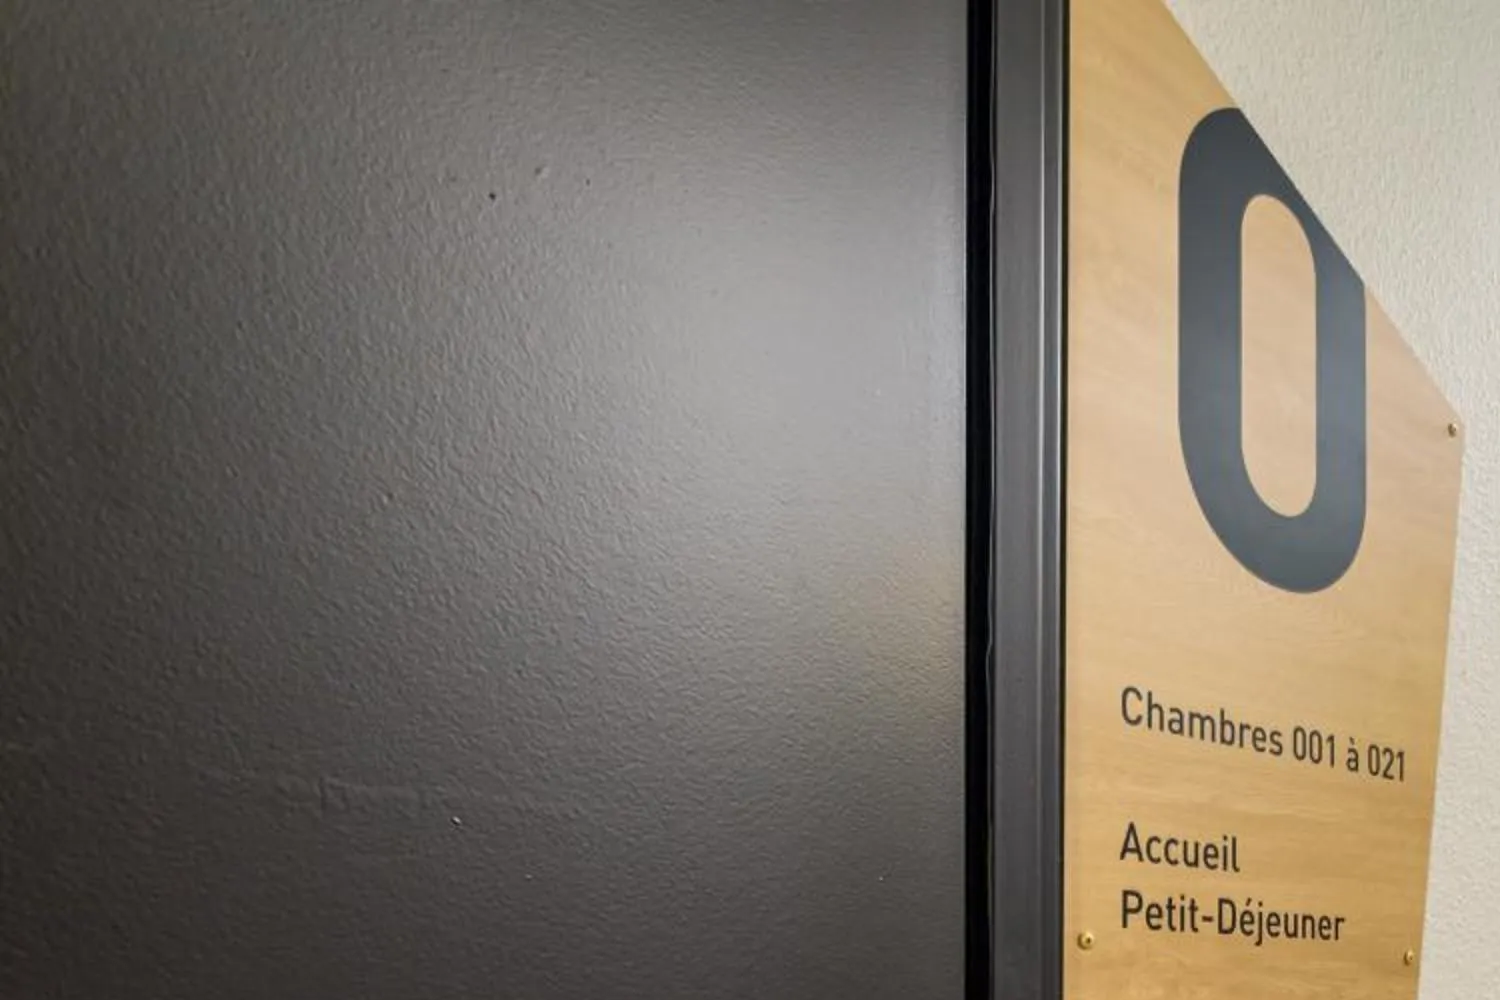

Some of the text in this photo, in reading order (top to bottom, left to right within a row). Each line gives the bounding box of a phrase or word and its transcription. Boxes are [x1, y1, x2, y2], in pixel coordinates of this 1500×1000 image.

[1178, 107, 1366, 594] 0
[1120, 686, 1405, 782] Chambres 001 à 021
[1119, 821, 1241, 873] Accueil
[1120, 888, 1347, 947] Petit-Déjeuner
